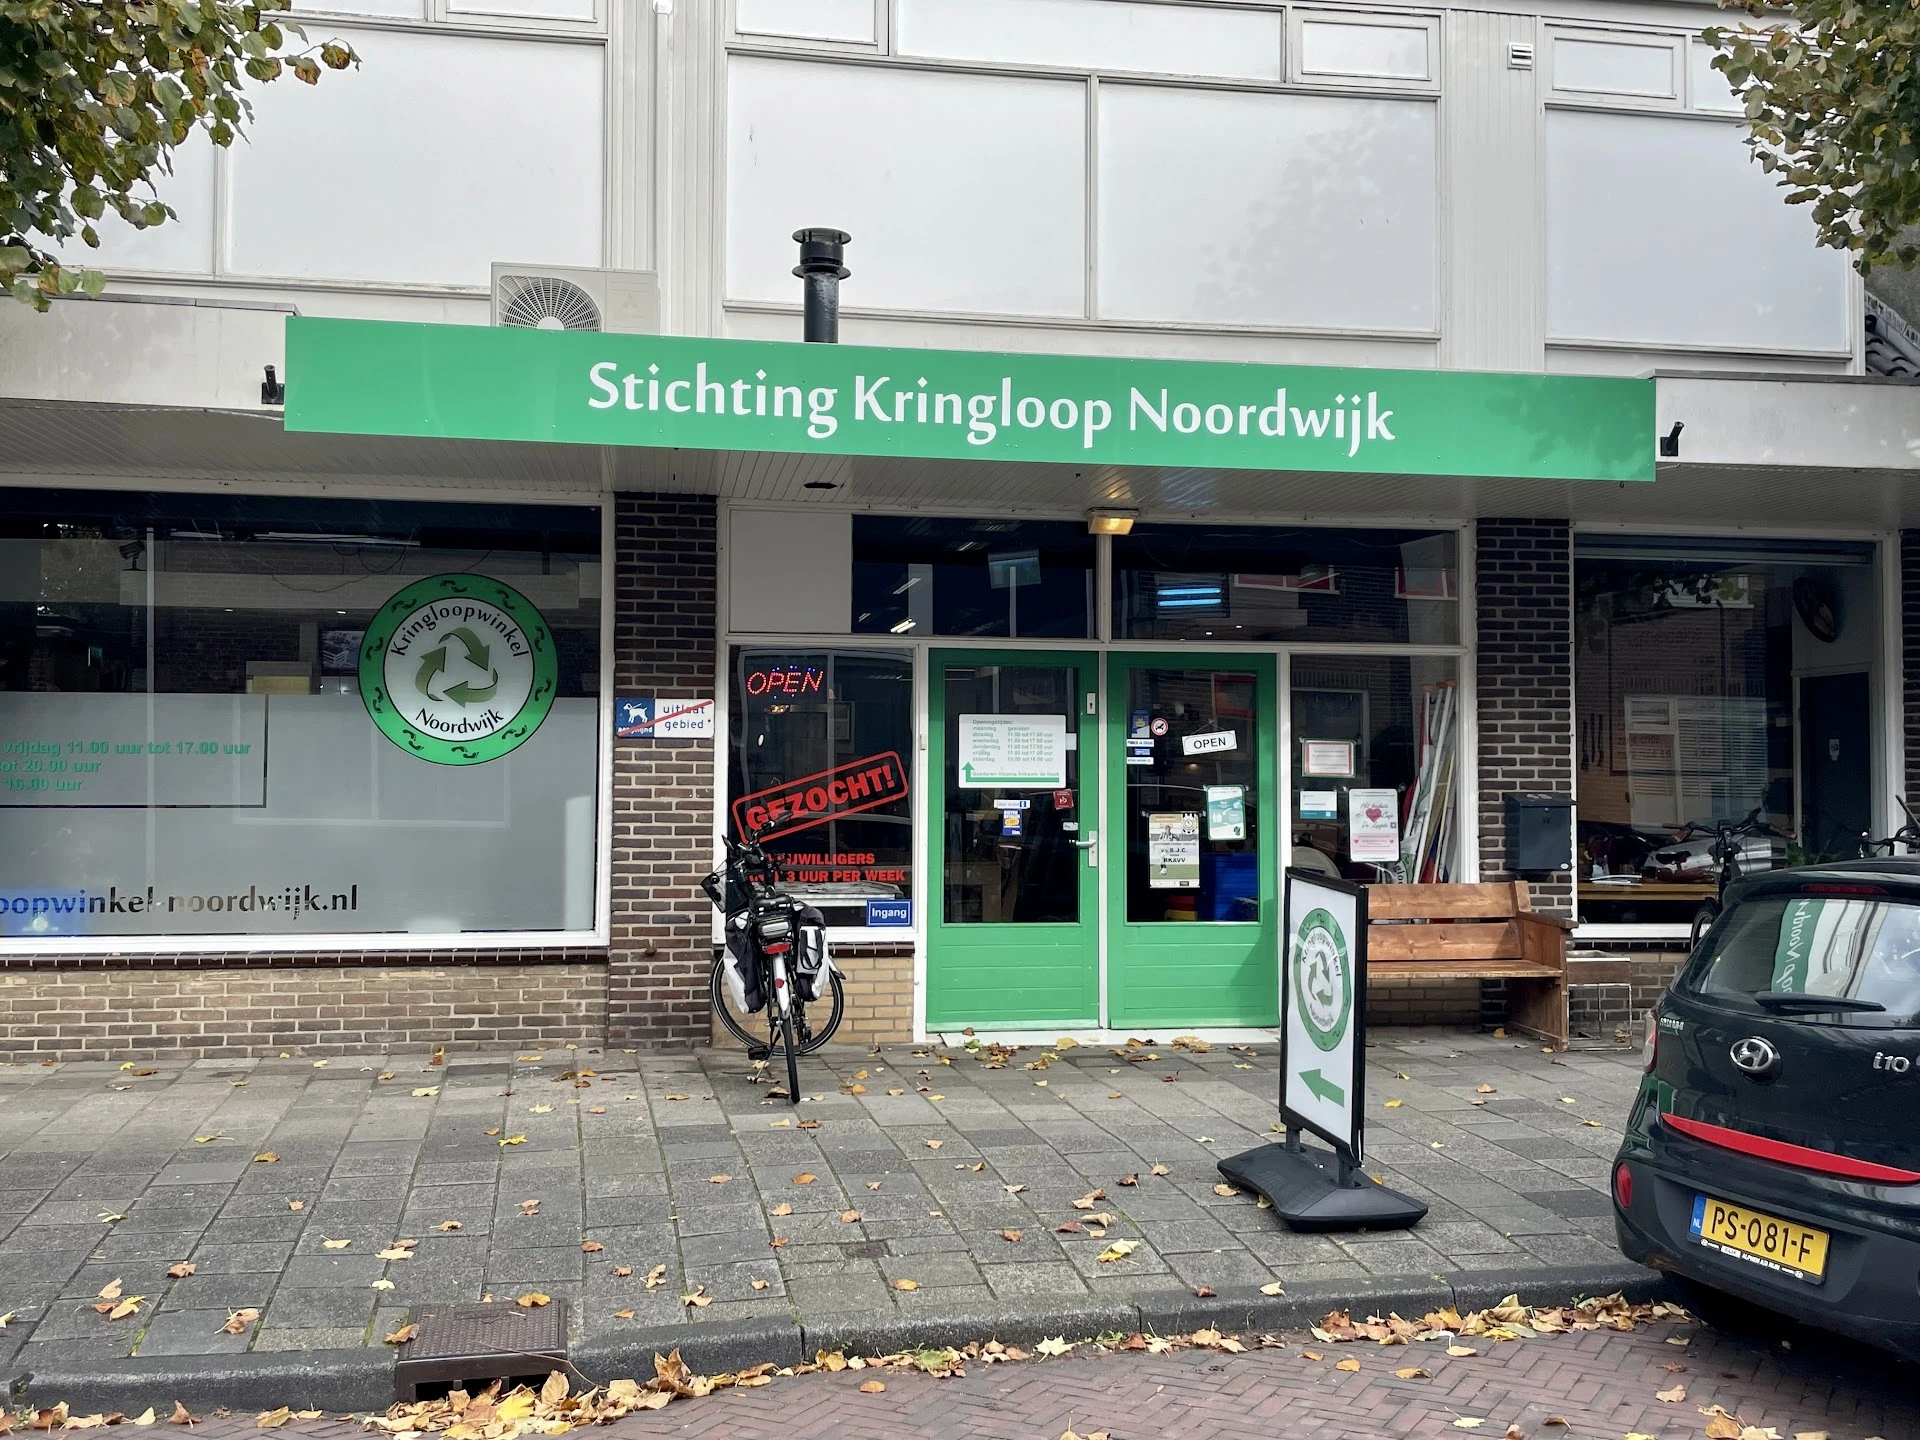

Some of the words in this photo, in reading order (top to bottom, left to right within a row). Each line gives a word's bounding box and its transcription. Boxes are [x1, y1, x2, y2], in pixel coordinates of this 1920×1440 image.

[587, 361, 838, 439] Stichting
[855, 375, 1112, 449] Kringloop
[1129, 386, 1396, 458] Noordwijk
[390, 604, 530, 657] Kringloopwinkel
[747, 670, 824, 695] OPEN
[415, 707, 504, 734] Noordwijk
[664, 720, 704, 731] gebied
[3, 741, 60, 757] vrijdag
[66, 741, 109, 754] 11.00
[115, 743, 143, 754] uur
[147, 741, 170, 754] tot
[175, 741, 218, 754] 17.00
[223, 743, 252, 754] uur
[1193, 736, 1226, 750] OPEN
[22, 759, 67, 772] 20.00
[73, 762, 102, 772] uur
[5, 778, 48, 790] 16.00
[55, 780, 84, 790] uur
[746, 764, 896, 831] GEZOCHT!
[786, 870, 796, 883] 3
[799, 870, 829, 882] UUR
[832, 870, 862, 882] PER
[865, 869, 906, 882] WEEK
[871, 907, 908, 919] Ingang
[1873, 1051, 1910, 1072] i10
[1692, 1218, 1702, 1228] NL
[1711, 1206, 1815, 1263] PS-081-F
